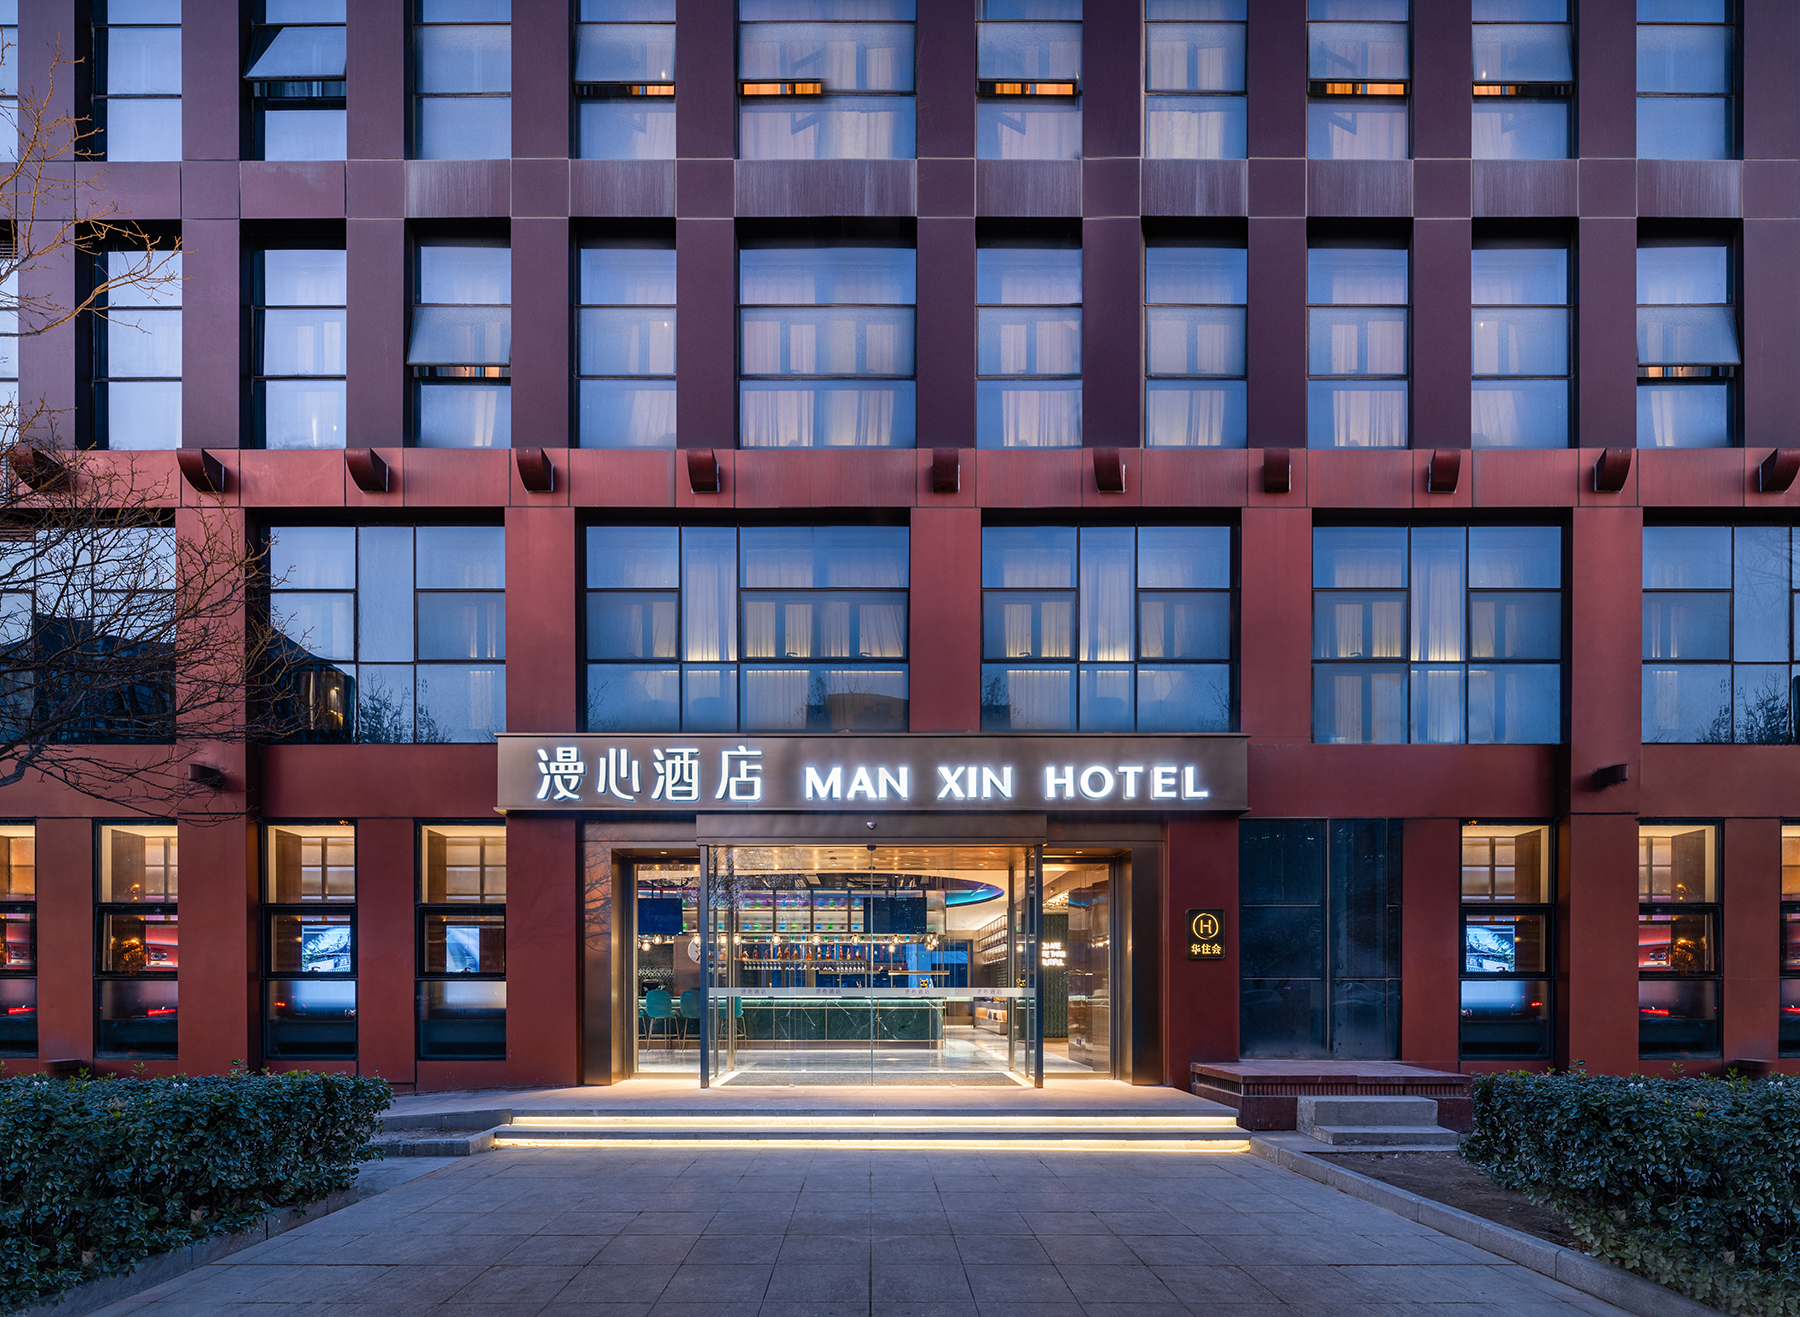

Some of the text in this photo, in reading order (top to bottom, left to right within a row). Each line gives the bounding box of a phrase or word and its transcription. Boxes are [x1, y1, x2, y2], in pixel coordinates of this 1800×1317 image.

[536, 745, 763, 802] 漫心酒店
[805, 765, 1209, 800] MAN XIN HOTEL
[1191, 943, 1222, 955] 华住会
